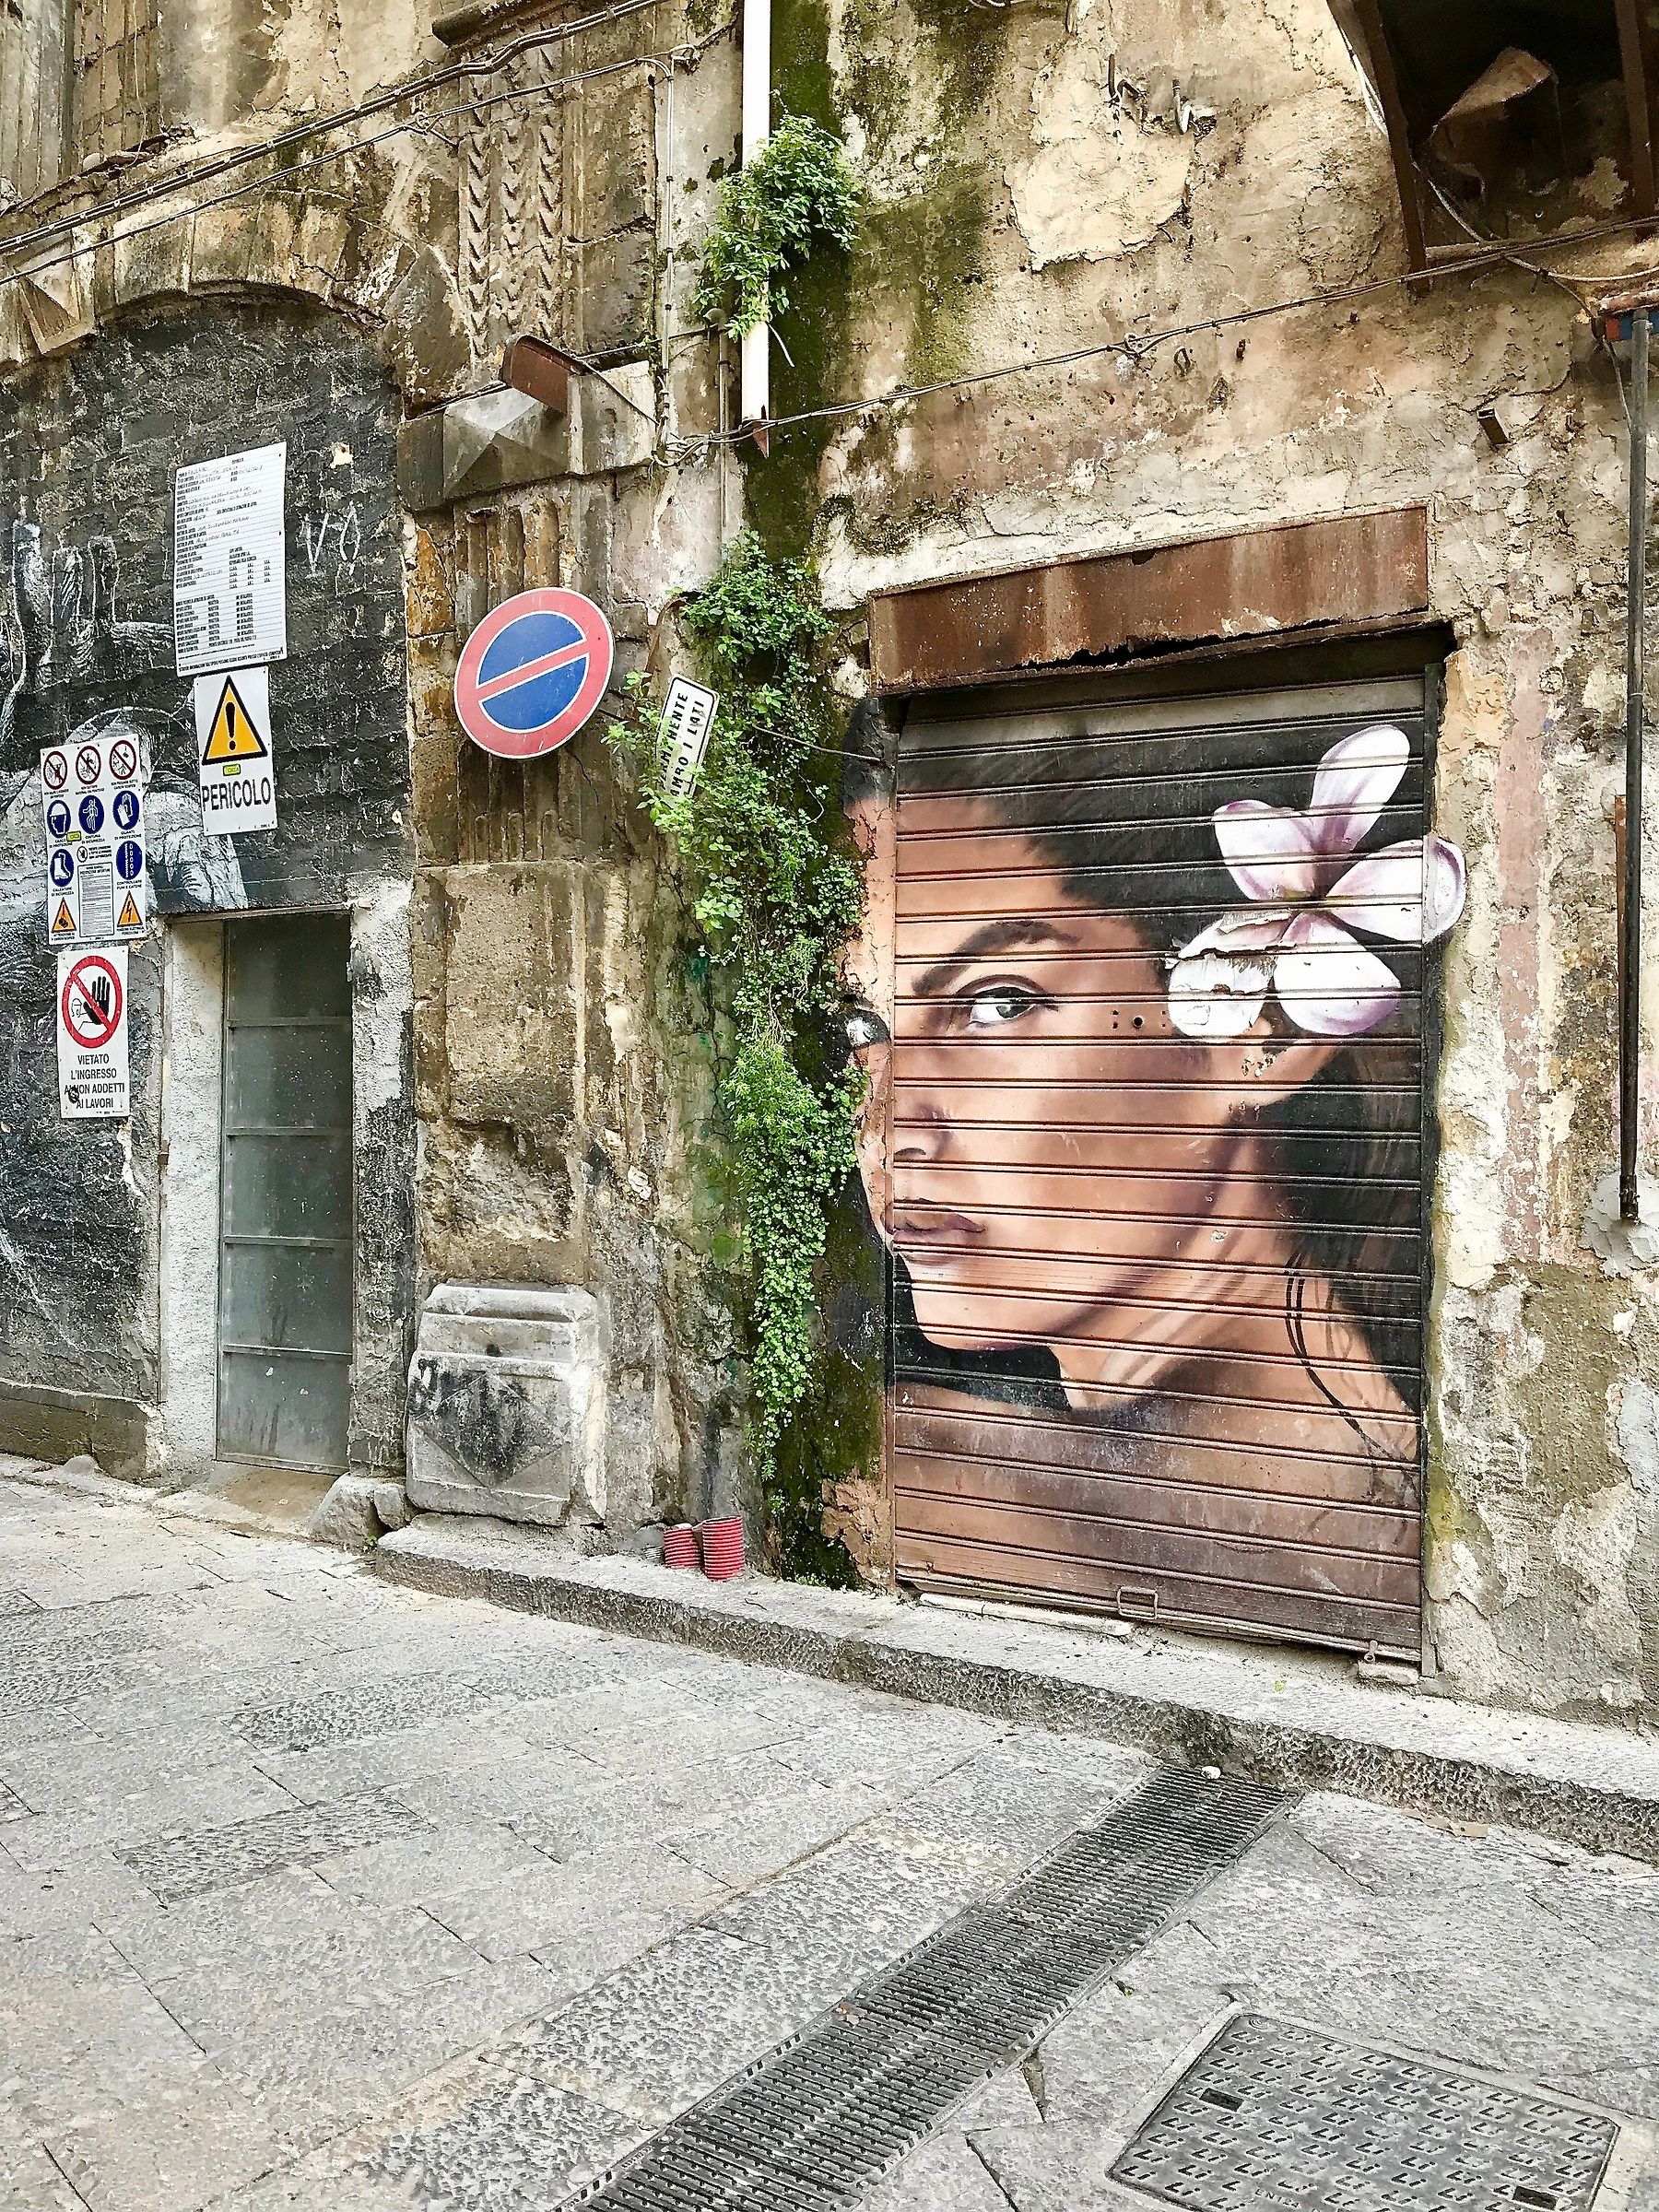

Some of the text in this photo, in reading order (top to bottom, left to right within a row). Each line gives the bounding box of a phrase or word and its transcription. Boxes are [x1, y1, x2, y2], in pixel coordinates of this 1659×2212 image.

[687, 700, 704, 735] LATI
[201, 777, 271, 812] PERICOLO
[77, 1053, 110, 1065] VIETATO
[70, 1068, 117, 1080] L'INGRESSO
[92, 1083, 125, 1094] ADDETTI
[76, 1098, 113, 1109] AI LAVORI
